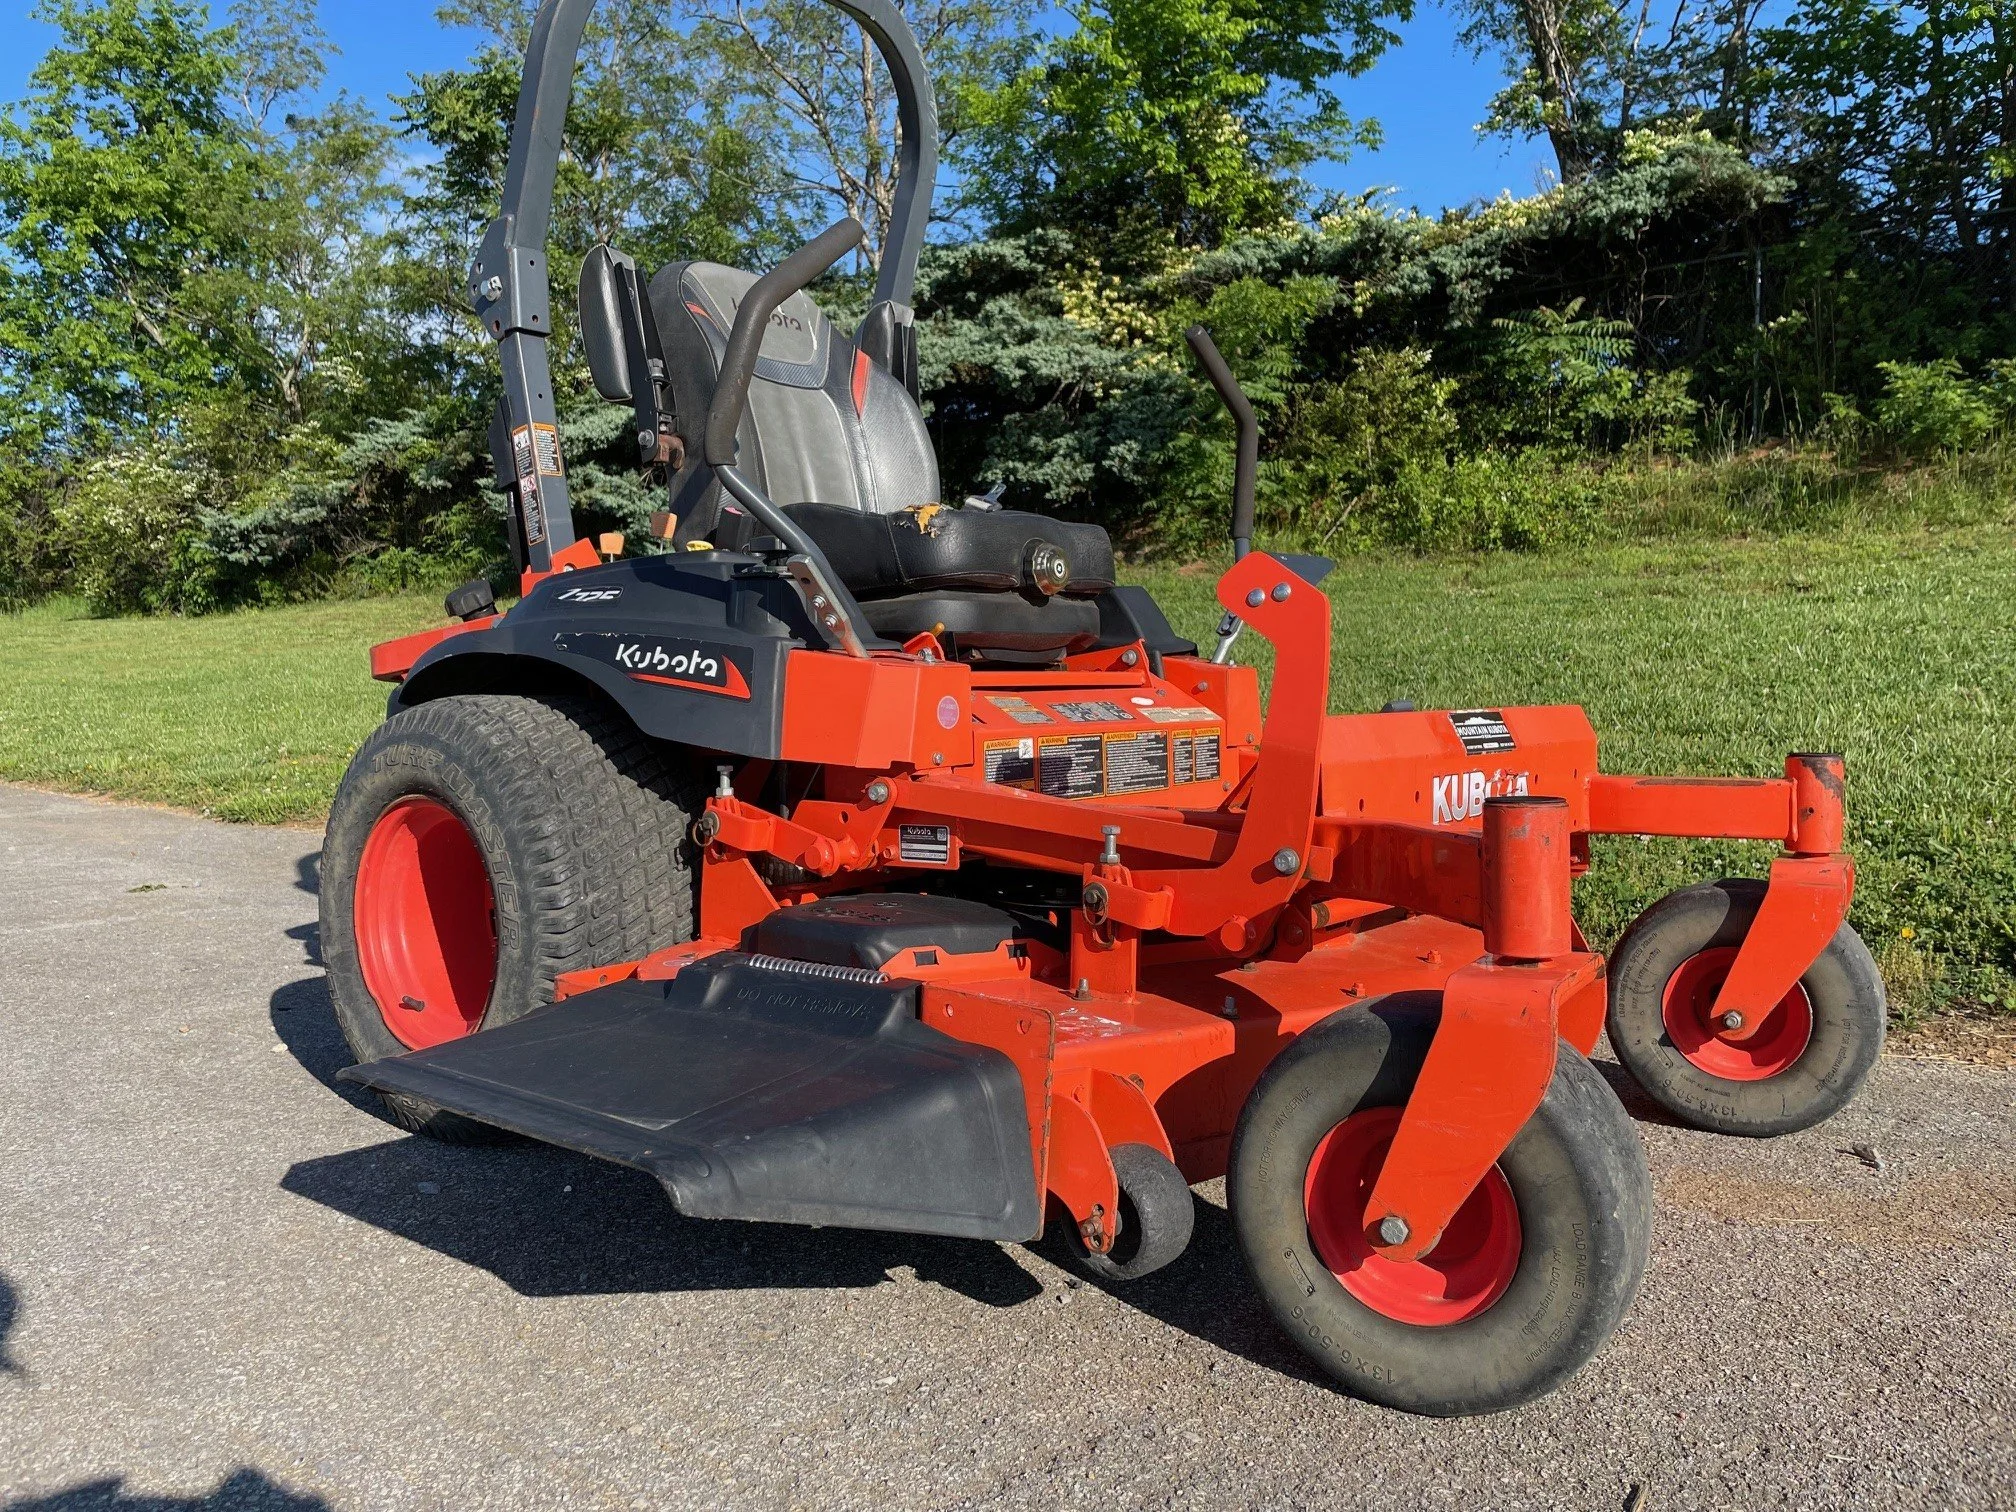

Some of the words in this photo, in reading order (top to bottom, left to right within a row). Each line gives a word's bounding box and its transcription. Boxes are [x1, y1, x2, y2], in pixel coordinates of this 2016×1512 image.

[615, 643, 718, 678] Kubota
[1456, 725, 1487, 736] MOUNTAIN
[1487, 724, 1509, 734] KUBOTA
[990, 740, 1012, 748] WARNING
[907, 826, 931, 835] Kubota
[372, 744, 444, 773] TURF
[442, 762, 522, 950] MASTER
[737, 987, 761, 1001] DO
[766, 991, 802, 1008] NOT
[1285, 1086, 1313, 1114] SERVICE
[1266, 1110, 1289, 1146] HIGHWAY
[1261, 1146, 1272, 1164] FOR
[1259, 1164, 1268, 1183] NOT
[1571, 1222, 1586, 1251] LOAD
[1549, 1266, 1561, 1289] LOAD
[1574, 1253, 1588, 1289] RANGE
[1571, 1290, 1582, 1301] B
[1563, 1301, 1578, 1321] MAX
[1548, 1320, 1569, 1344] SPEED
[1290, 1305, 1396, 1384] 13X6.50-6
